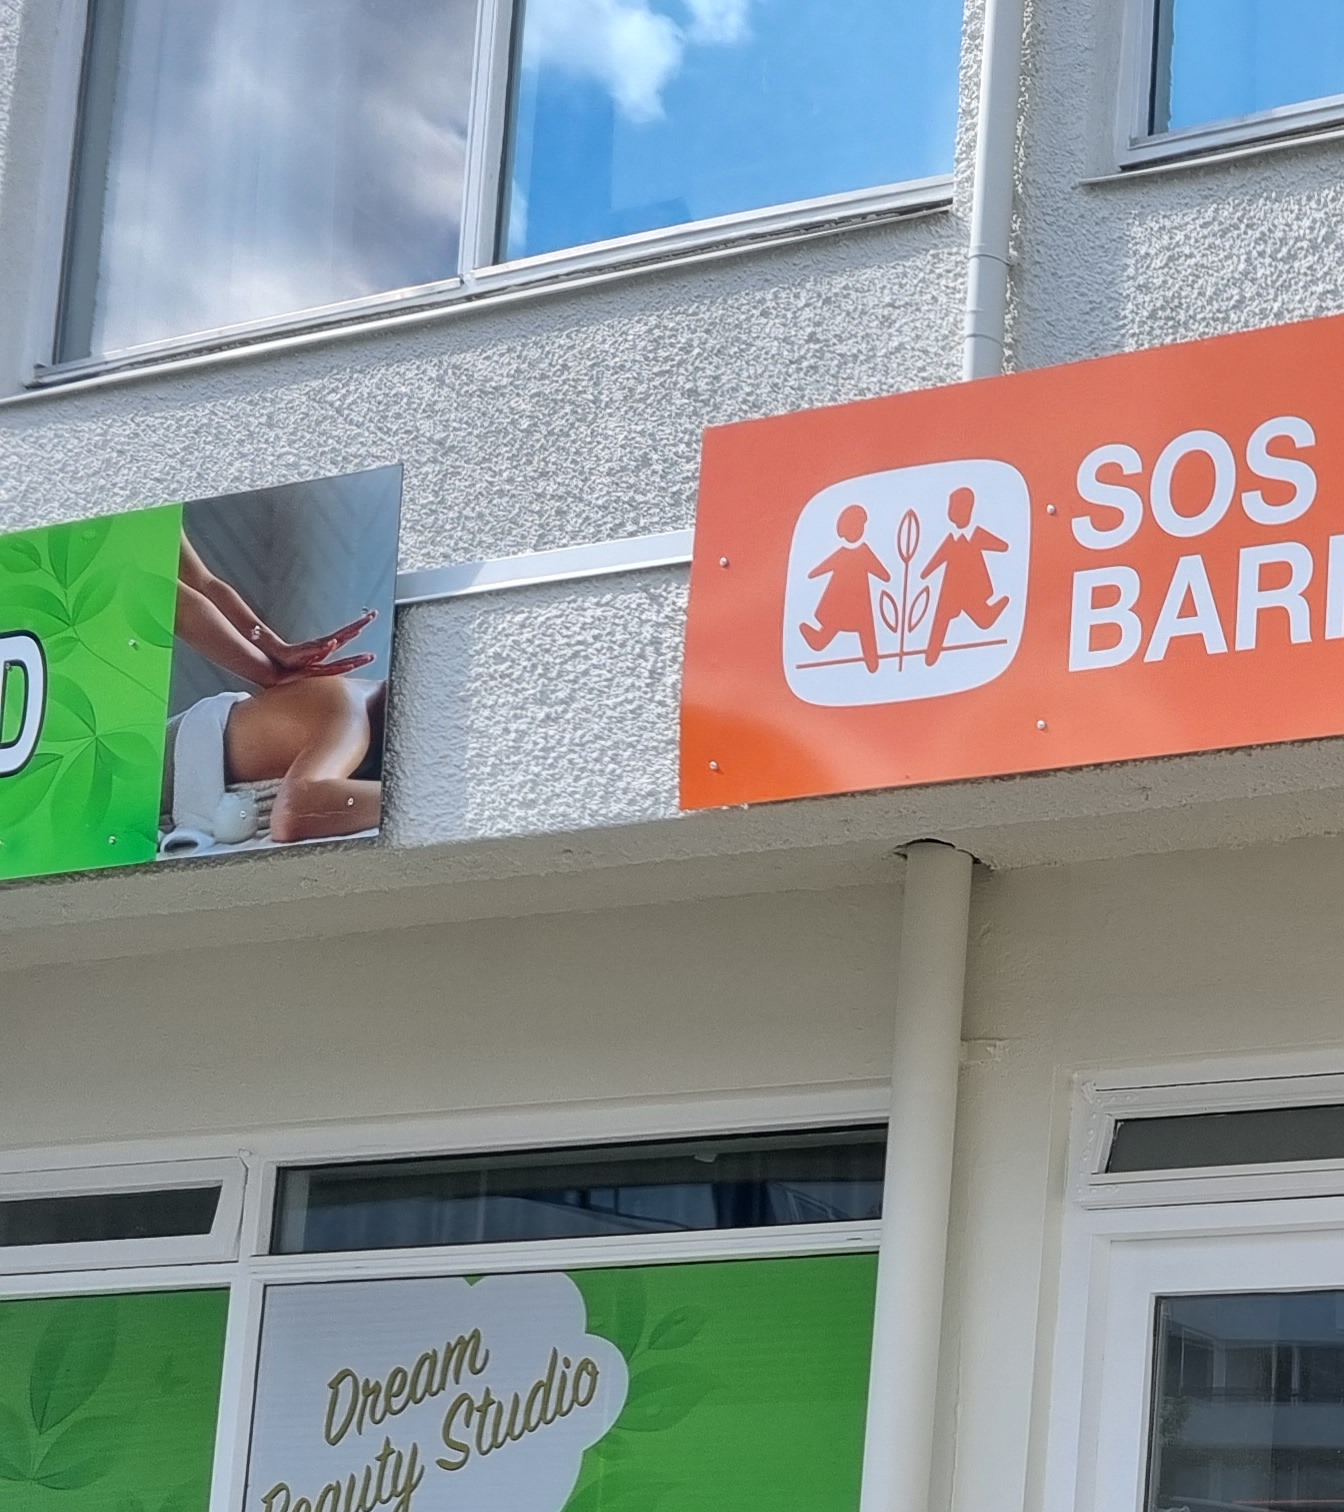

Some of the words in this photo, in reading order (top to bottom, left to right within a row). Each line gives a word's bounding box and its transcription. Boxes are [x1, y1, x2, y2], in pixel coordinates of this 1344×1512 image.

[1072, 416, 1317, 551] SOS
[325, 1327, 490, 1447] Dream
[436, 1346, 600, 1472] Studio
